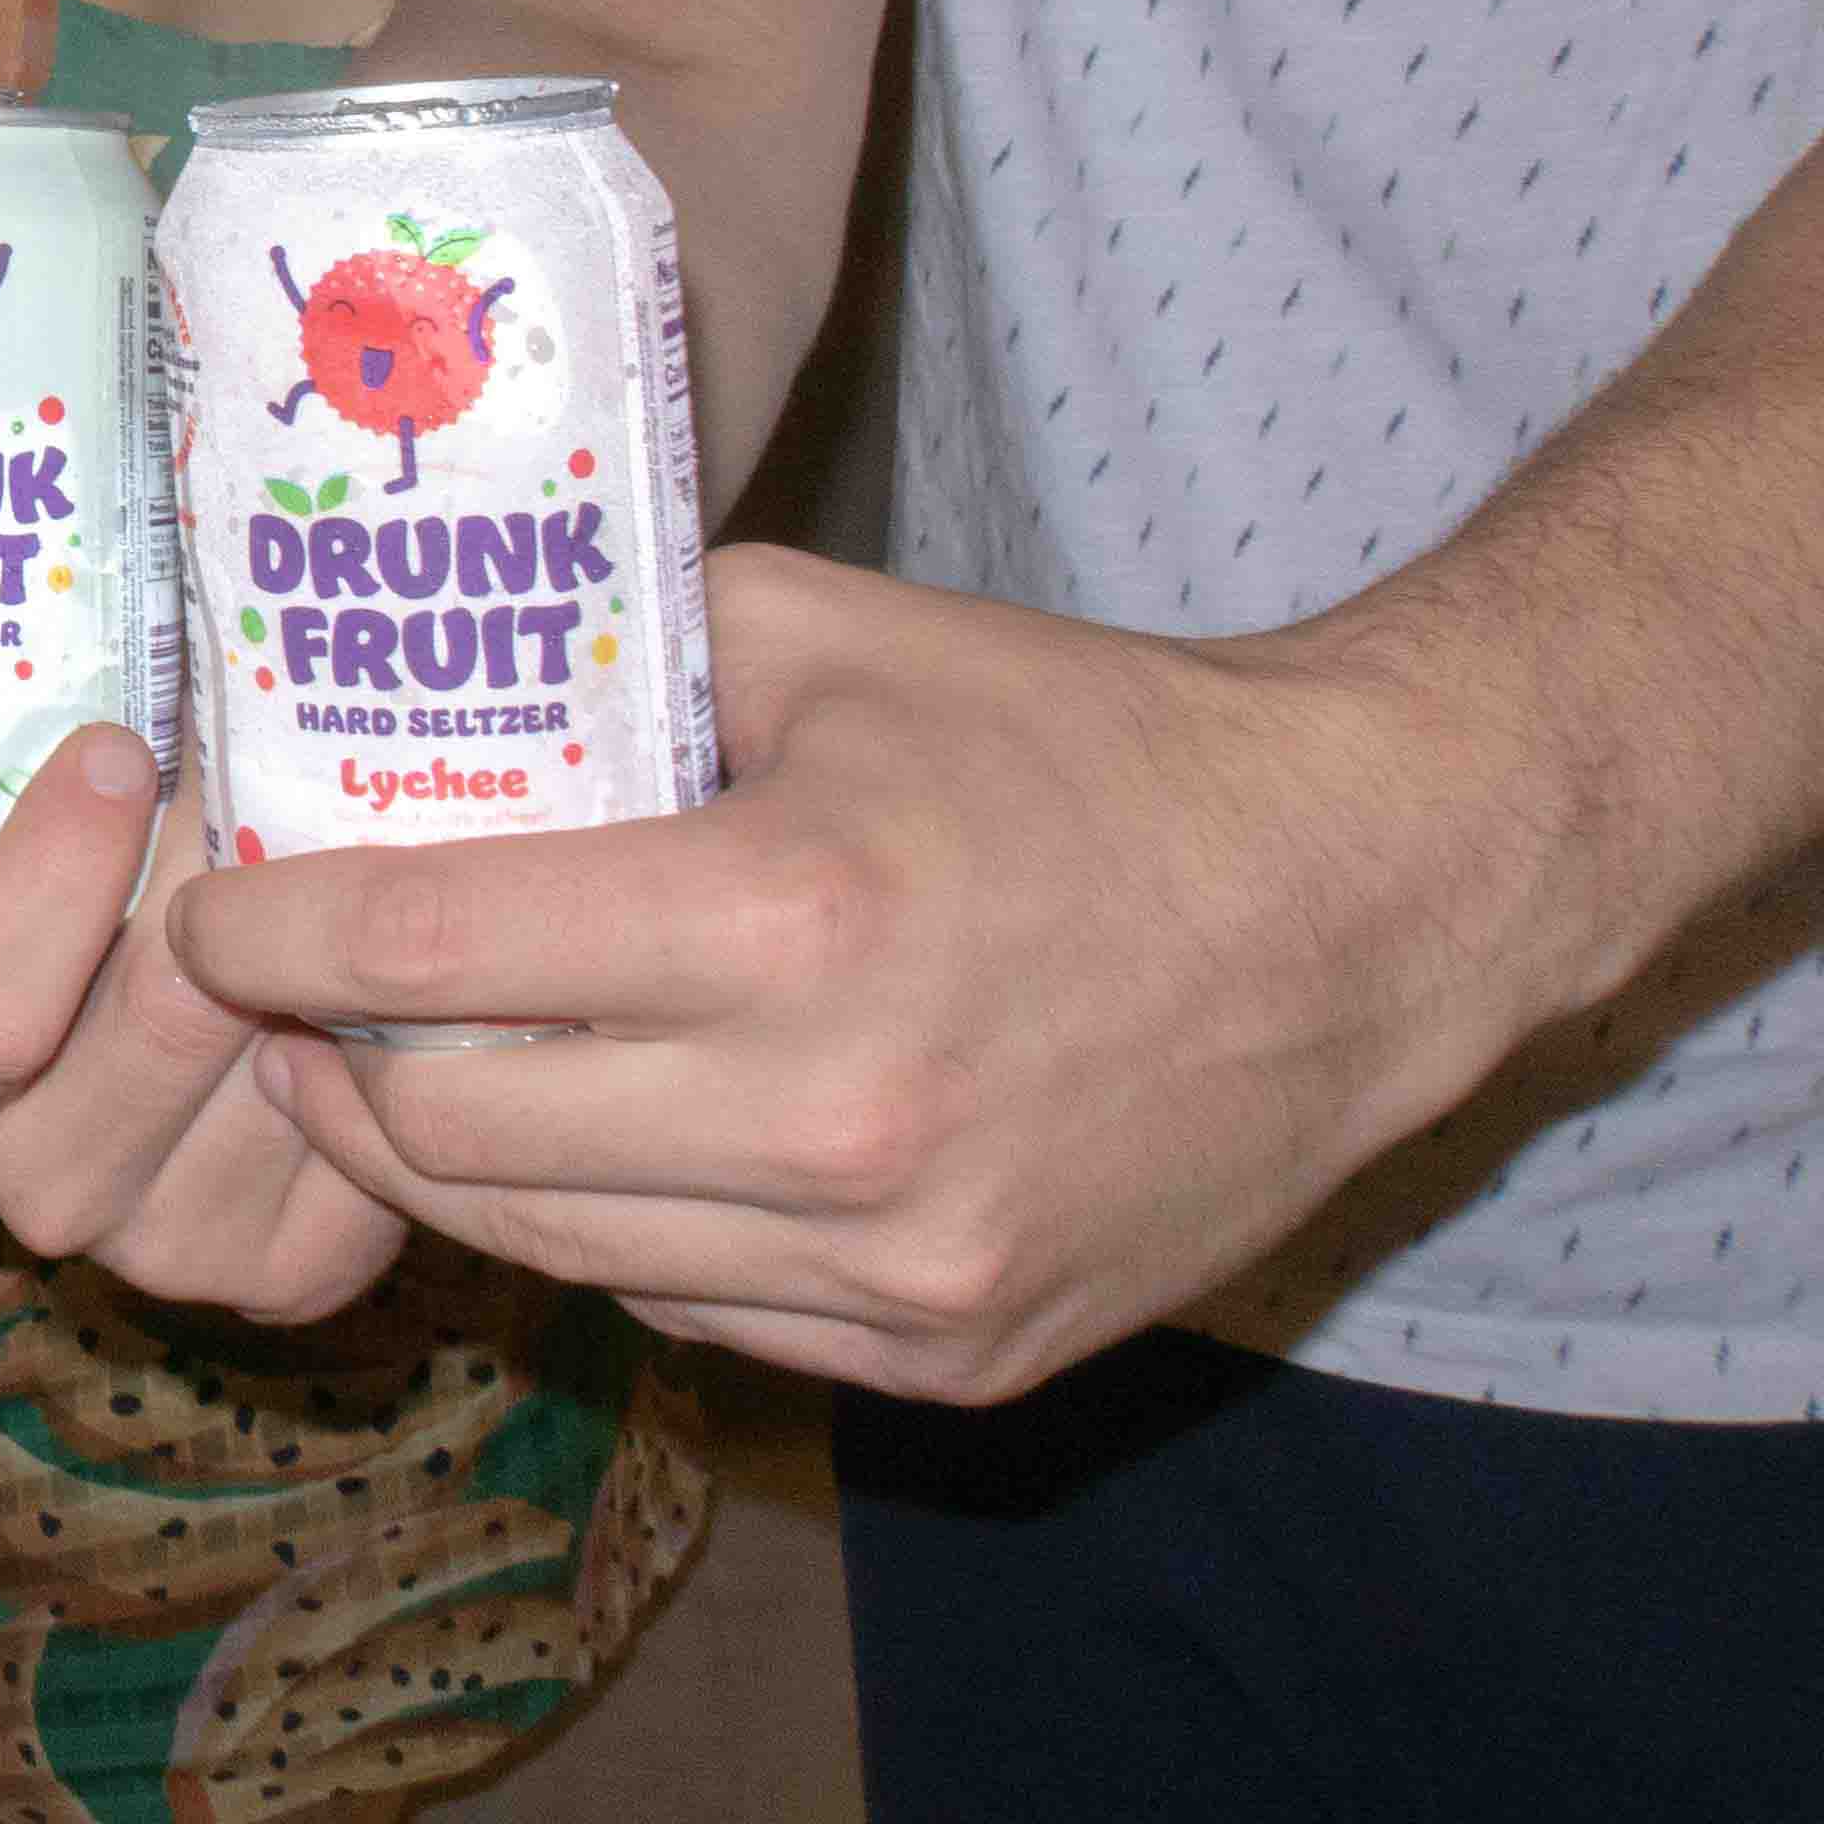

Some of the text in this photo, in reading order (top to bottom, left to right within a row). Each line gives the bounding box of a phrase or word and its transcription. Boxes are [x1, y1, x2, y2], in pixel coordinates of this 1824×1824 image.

[249, 501, 614, 600] DRUNK
[280, 600, 582, 692] FRUIT
[295, 701, 570, 738] HARD SELTZER
[340, 757, 529, 812] Lychee
